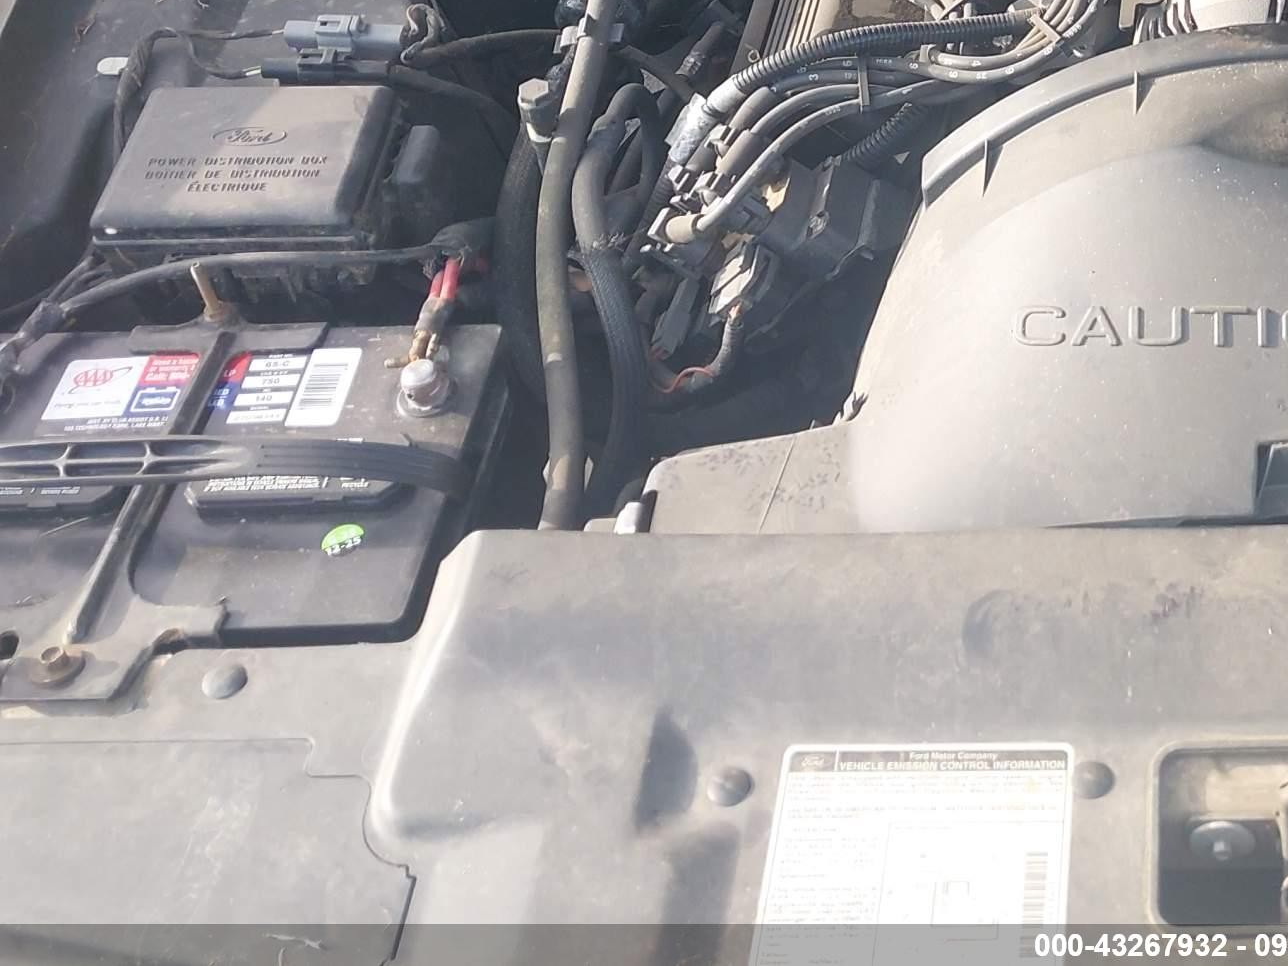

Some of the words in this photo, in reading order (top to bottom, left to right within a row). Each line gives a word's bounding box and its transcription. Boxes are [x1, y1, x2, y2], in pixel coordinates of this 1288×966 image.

[228, 129, 274, 145] Ford
[147, 156, 197, 167] POWER
[204, 156, 294, 167] DISTRIBUTION
[301, 155, 328, 166] BOX
[204, 169, 223, 179] DE
[230, 168, 321, 179] DISTRIBUTION
[187, 180, 268, 193] ÉLECTRIQUE
[326, 536, 362, 556] 12-25
[909, 751, 930, 760] Ford
[932, 751, 956, 760] Motor
[957, 751, 999, 761] Company
[839, 761, 886, 771] VEHICLE
[887, 761, 938, 771] EMISSION
[940, 761, 991, 771] CONTROL
[992, 760, 1066, 770] INFORMATION
